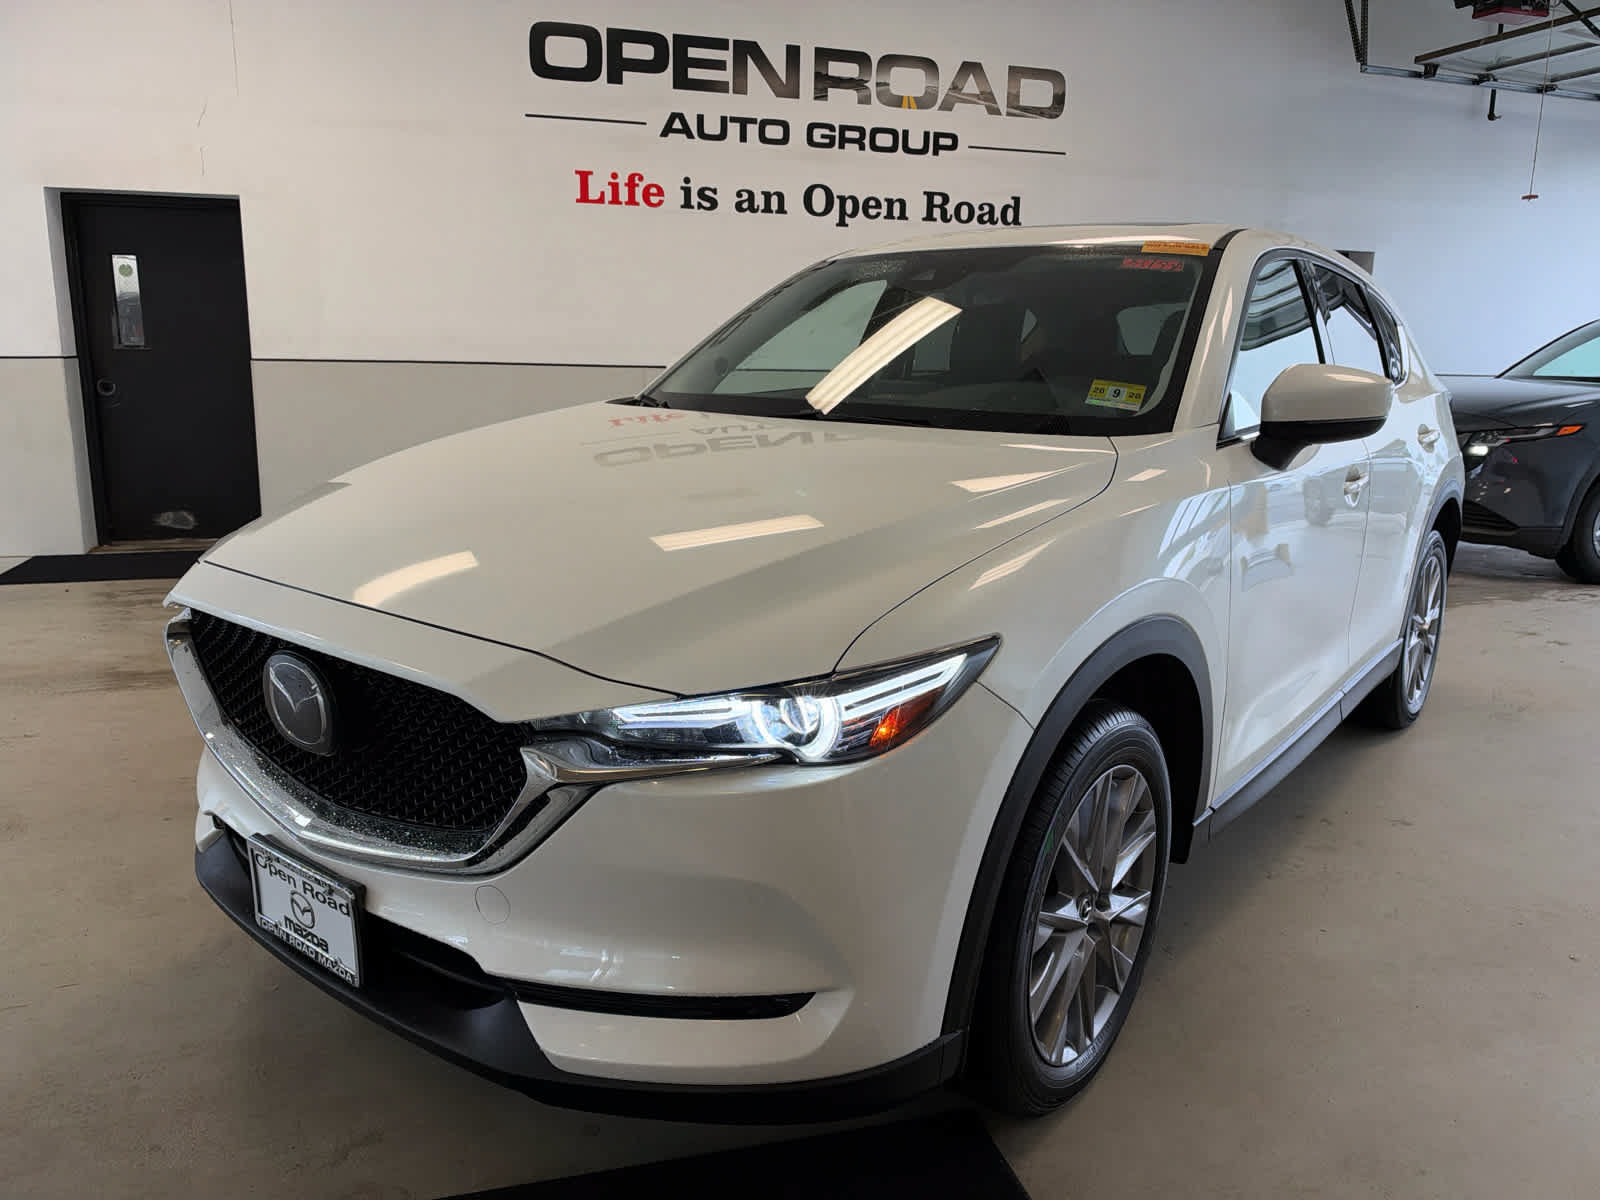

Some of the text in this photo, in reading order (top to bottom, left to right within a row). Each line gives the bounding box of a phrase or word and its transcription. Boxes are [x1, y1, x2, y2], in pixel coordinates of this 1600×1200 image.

[529, 20, 1067, 119] OPEN ROAD
[659, 112, 959, 156] AUTO GROUP
[575, 170, 1022, 227] Life is an Open Road
[1112, 388, 1121, 399] 9
[255, 852, 351, 918] Open Road
[319, 954, 354, 985] MAZDA
